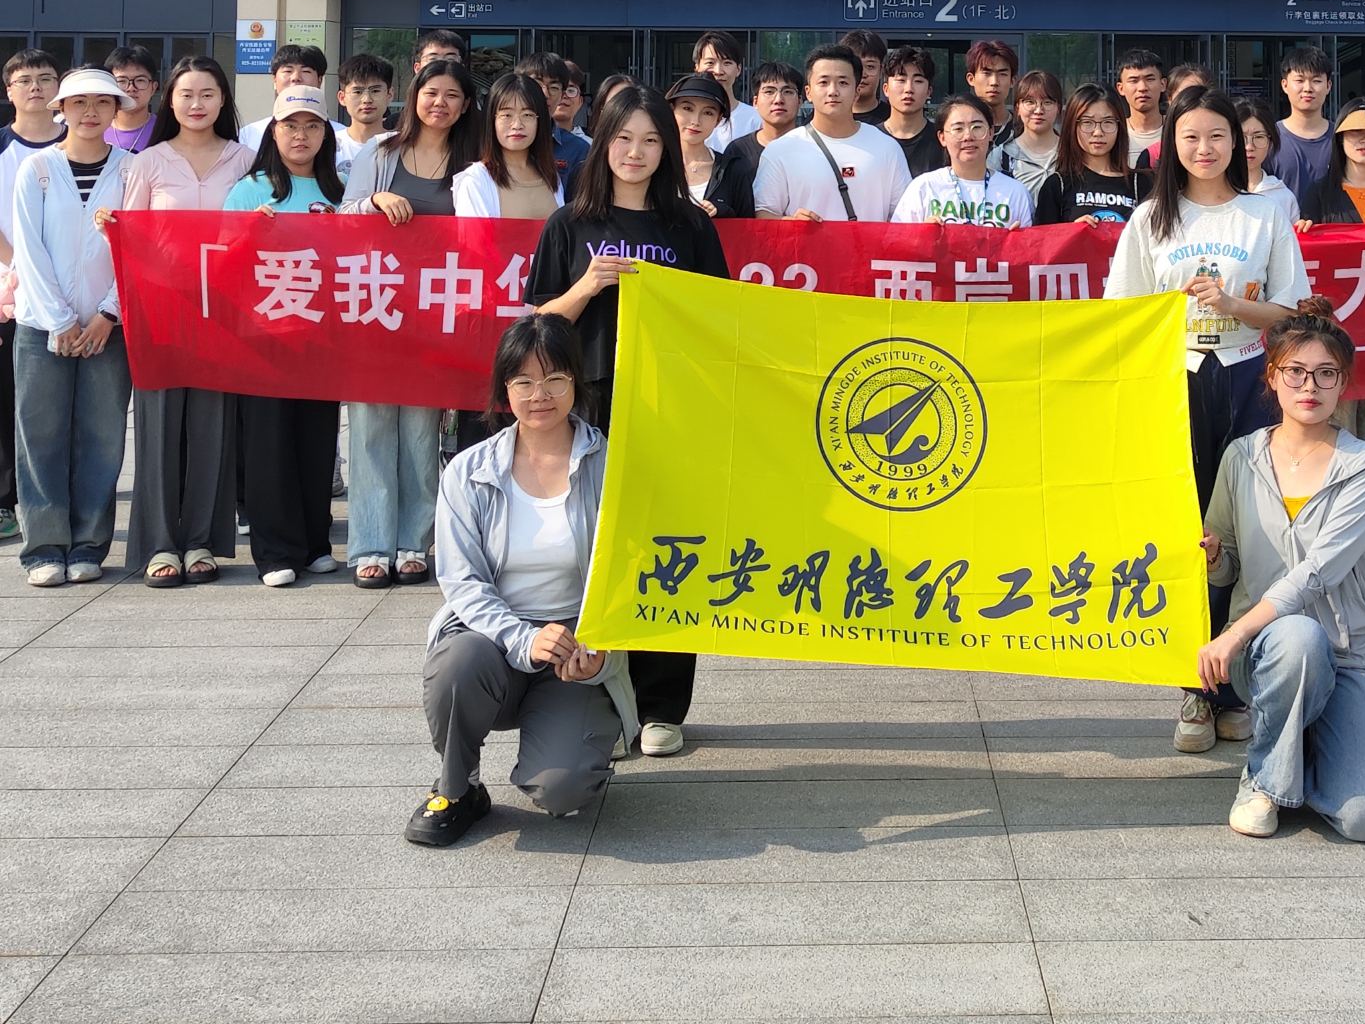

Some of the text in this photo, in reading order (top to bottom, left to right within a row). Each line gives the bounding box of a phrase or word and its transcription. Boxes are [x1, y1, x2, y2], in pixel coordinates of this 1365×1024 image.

[882, 10, 924, 18] Entrance
[930, 198, 1010, 222] BANGO
[831, 366, 861, 413] MINGDE
[861, 350, 927, 370] INSTITUTE
[929, 360, 946, 374] OF
[945, 372, 974, 458] TECHNOLOGY
[874, 460, 928, 478] 1999
[634, 603, 1171, 652] XI'AN MINGDE INSTITUTE OF TECHNOLOGY
